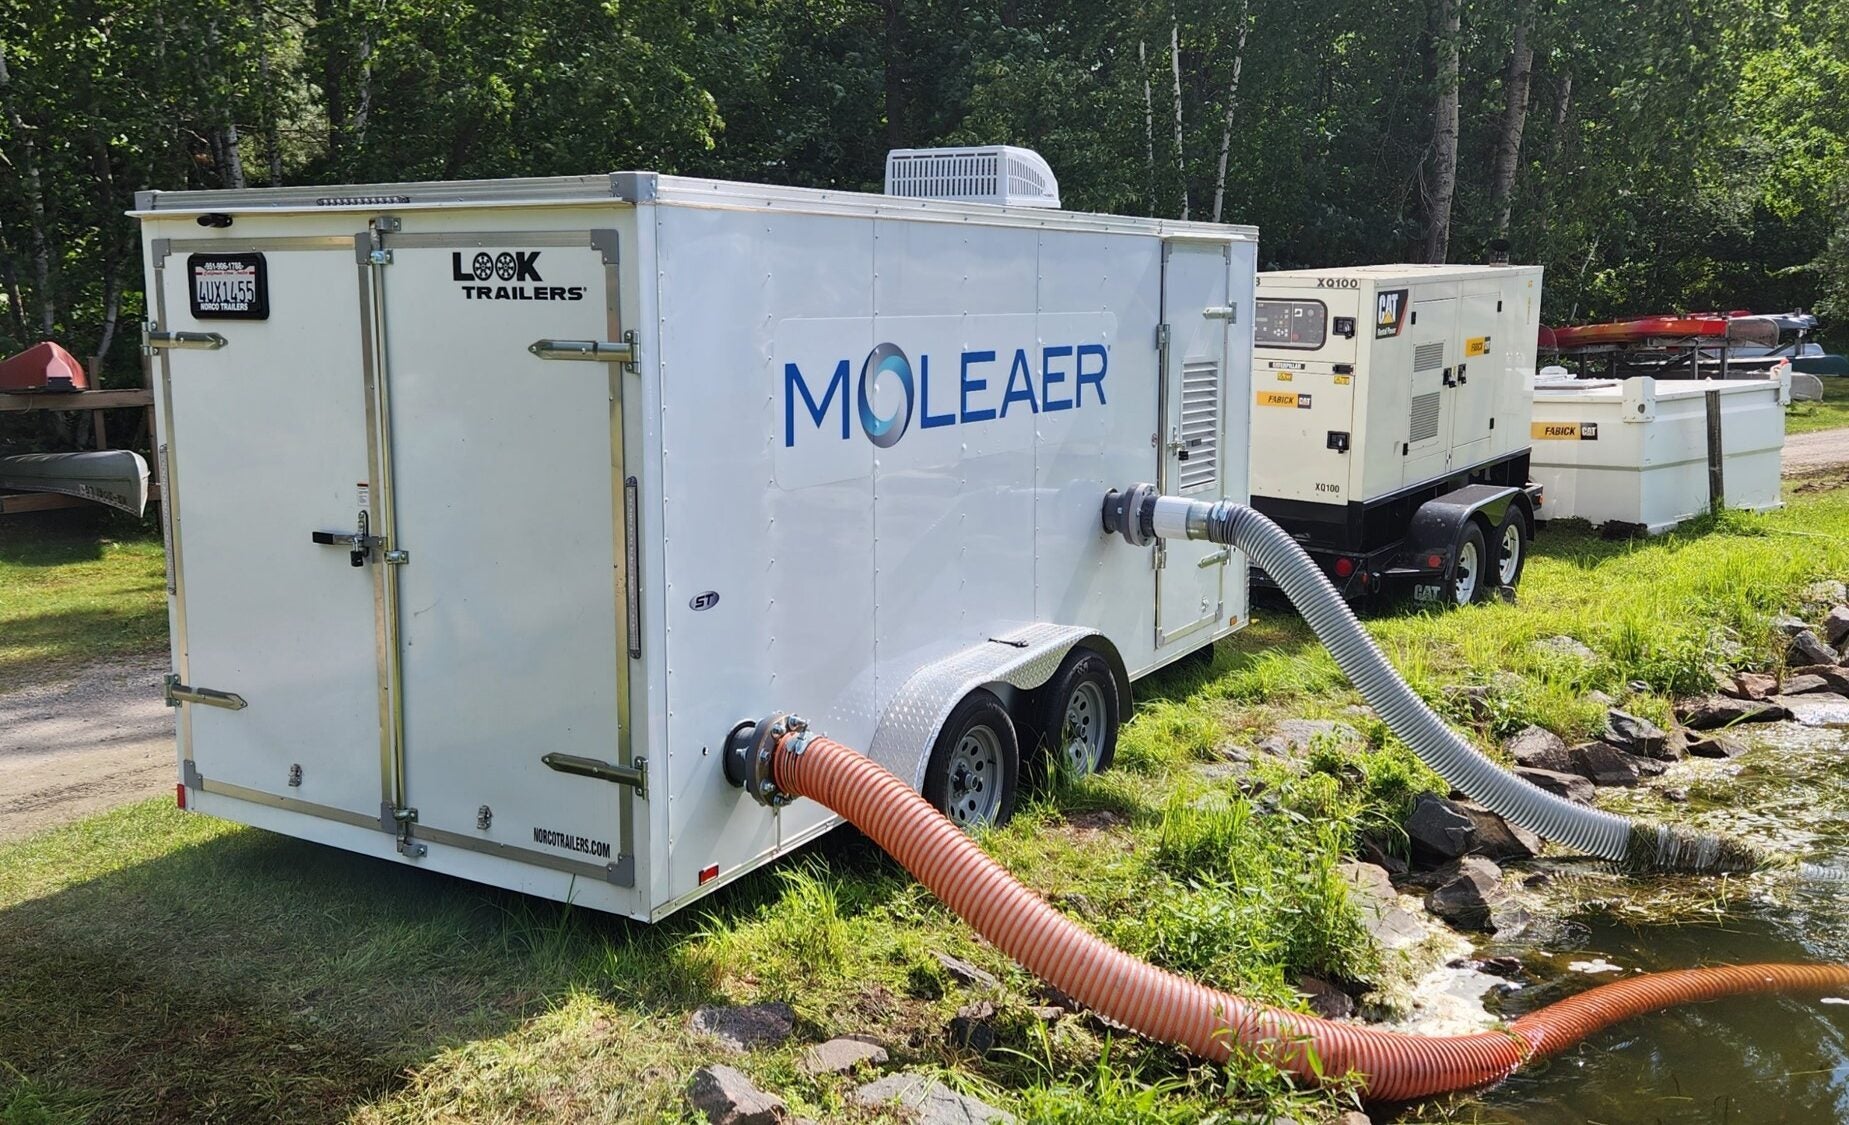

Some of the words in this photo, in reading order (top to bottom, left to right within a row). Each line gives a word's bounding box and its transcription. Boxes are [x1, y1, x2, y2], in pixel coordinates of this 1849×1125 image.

[452, 252, 543, 282] LOOK
[1317, 278, 1358, 288] XQ100
[200, 281, 254, 303] 4UX1455
[200, 303, 220, 311] NORCO
[221, 303, 249, 311] TRAILERS
[1378, 293, 1398, 324] CAT
[785, 342, 1108, 448] MOLEAER
[1268, 395, 1294, 404] FABICK
[1545, 426, 1576, 436] FABICK
[1581, 426, 1597, 436] CAT
[1315, 482, 1340, 493] XQ100
[695, 593, 714, 608] ST
[1414, 584, 1441, 601] CAT
[533, 827, 611, 859] NORCOTRAILERS.COM
